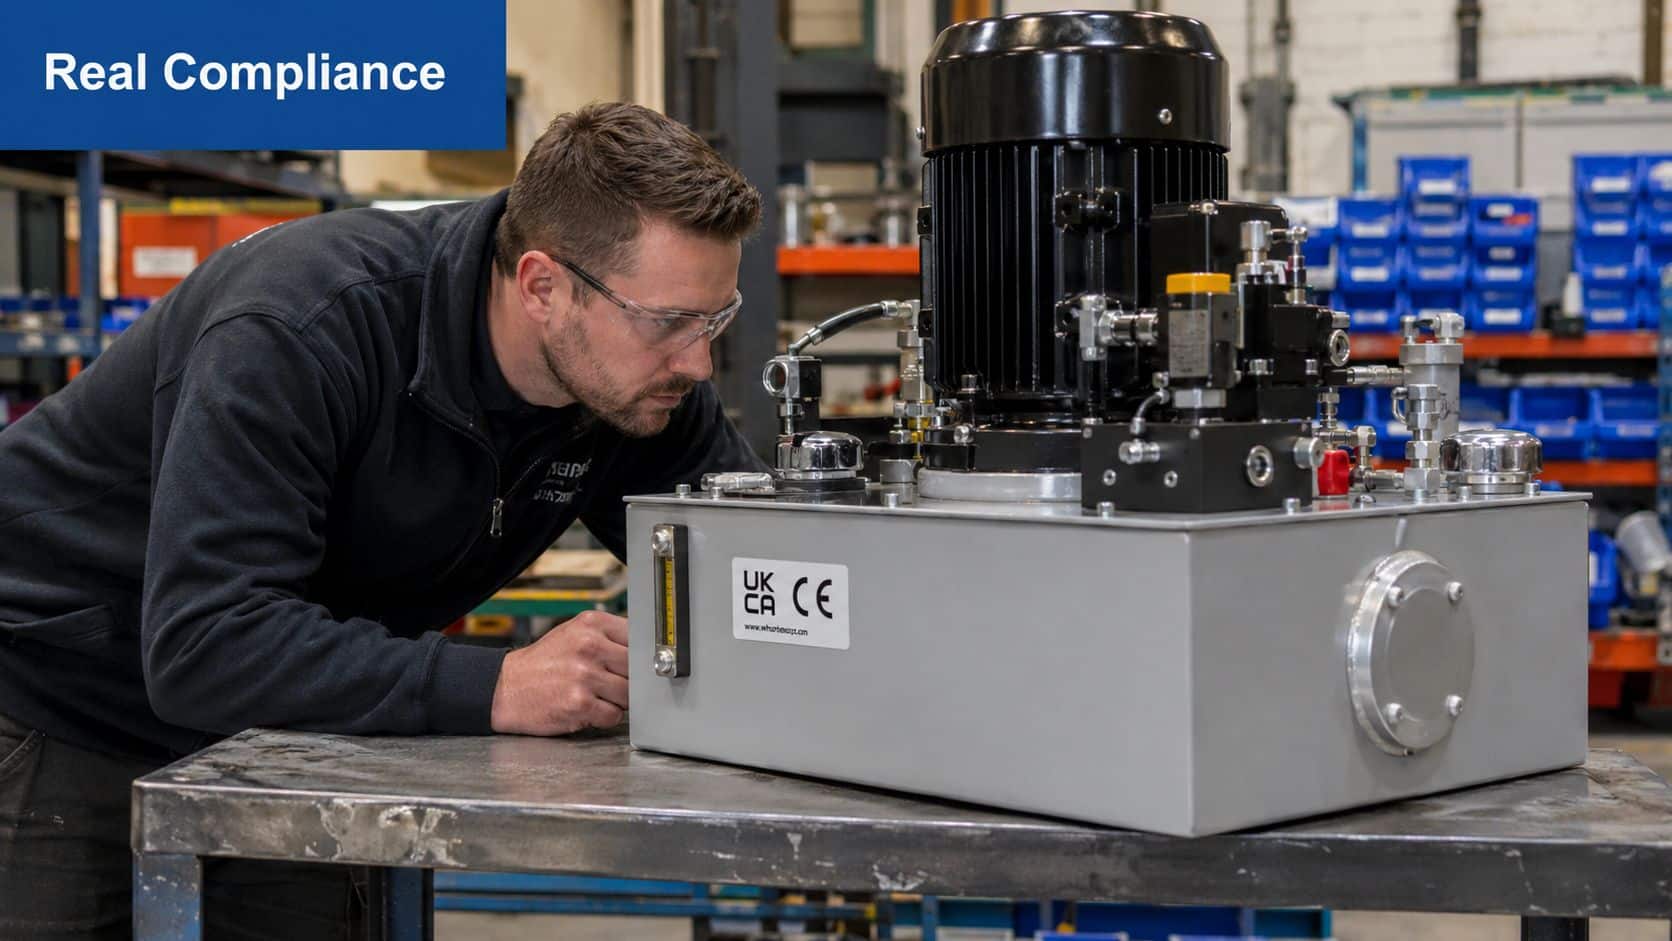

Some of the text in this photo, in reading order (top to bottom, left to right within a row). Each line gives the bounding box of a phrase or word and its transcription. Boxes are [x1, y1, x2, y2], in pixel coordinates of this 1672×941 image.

[744, 570, 775, 592] UK
[744, 593, 776, 616] CA
[792, 576, 833, 619] CE
